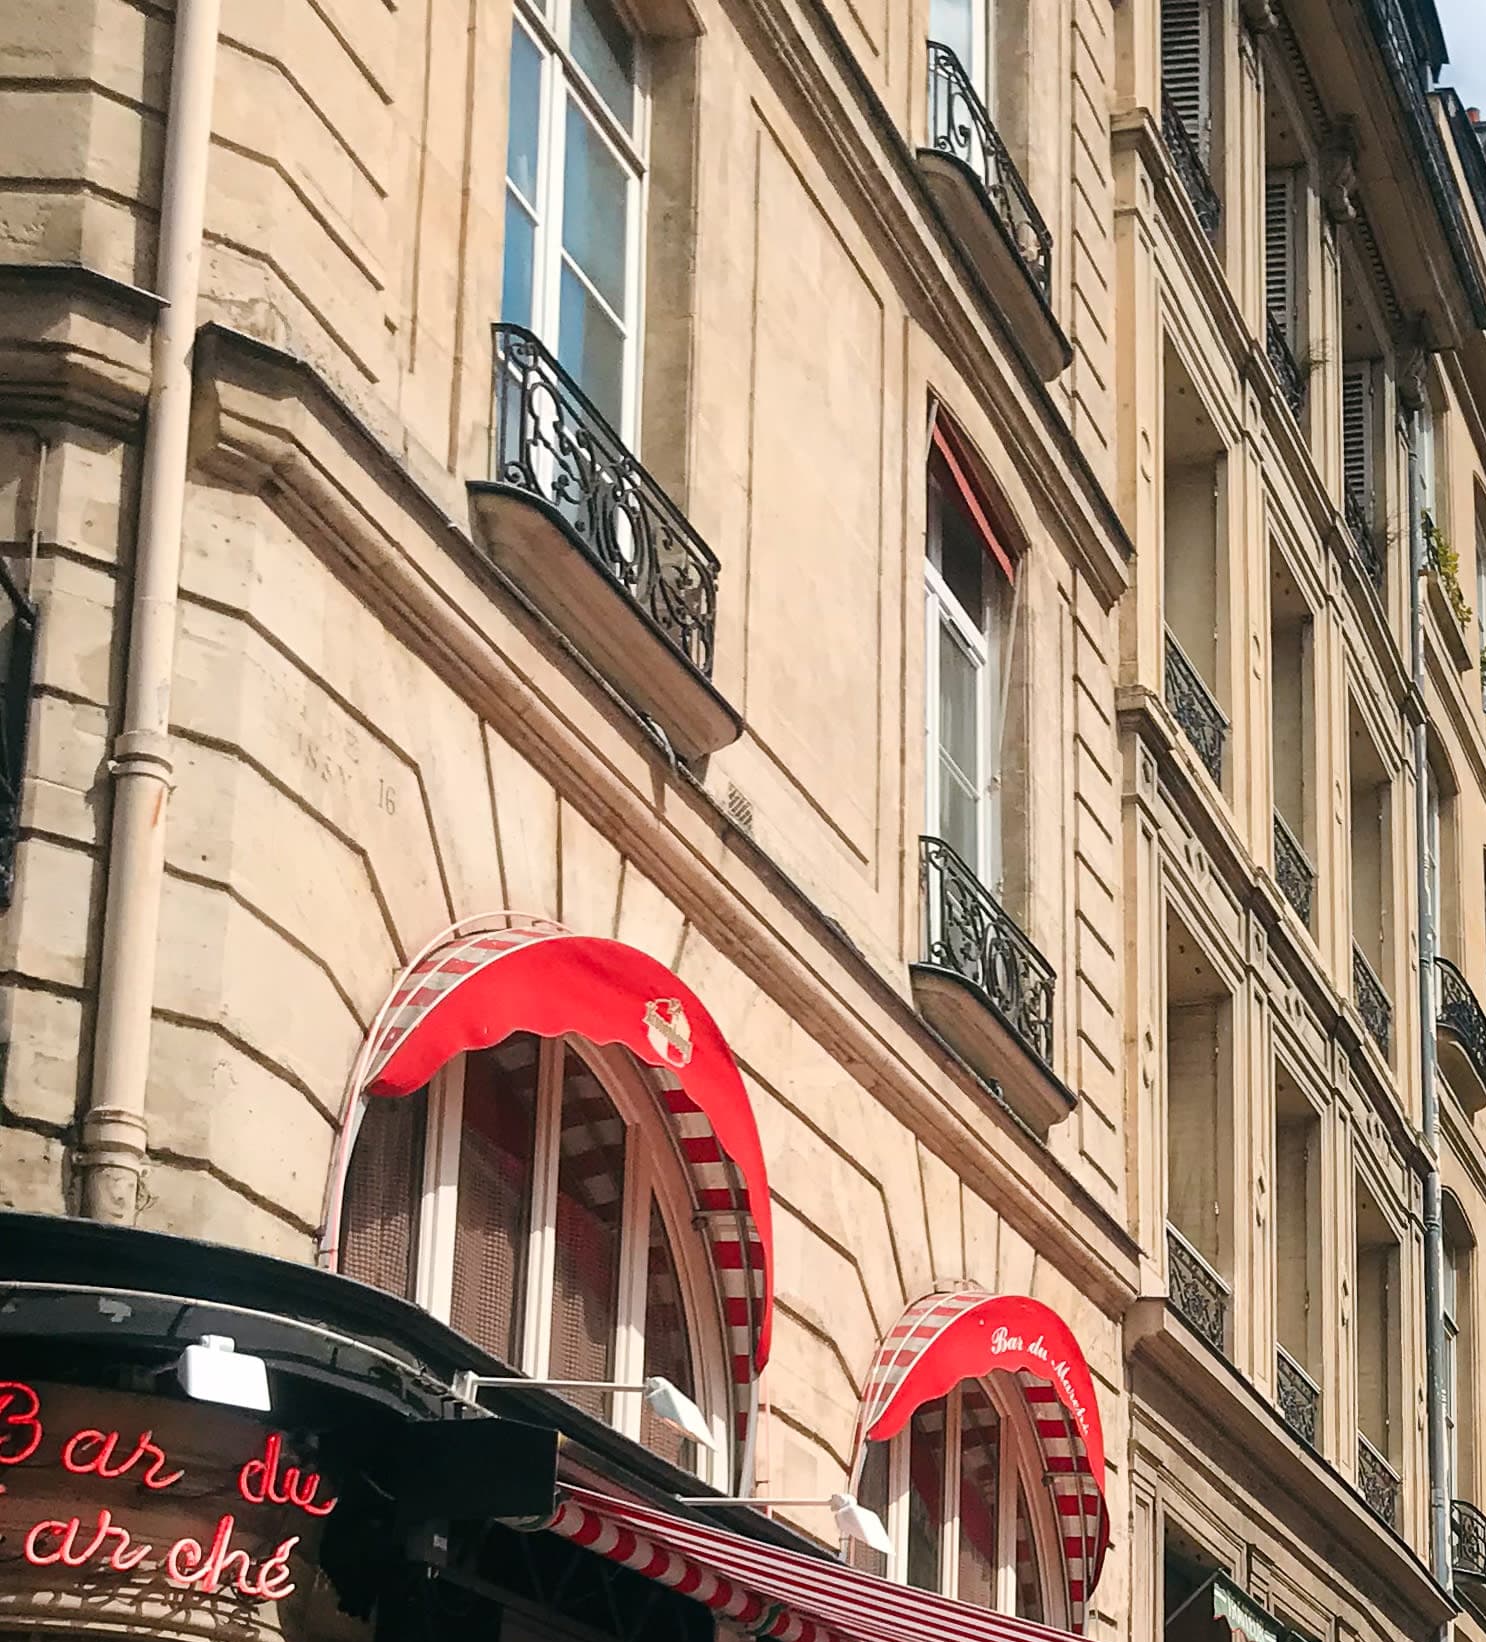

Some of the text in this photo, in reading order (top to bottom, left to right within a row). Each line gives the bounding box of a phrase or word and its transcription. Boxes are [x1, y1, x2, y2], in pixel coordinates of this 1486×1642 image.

[989, 1325, 1024, 1356] Bar
[1026, 1335, 1049, 1362] du
[0, 1380, 339, 1517] Bar du
[0, 1507, 301, 1601] arché
